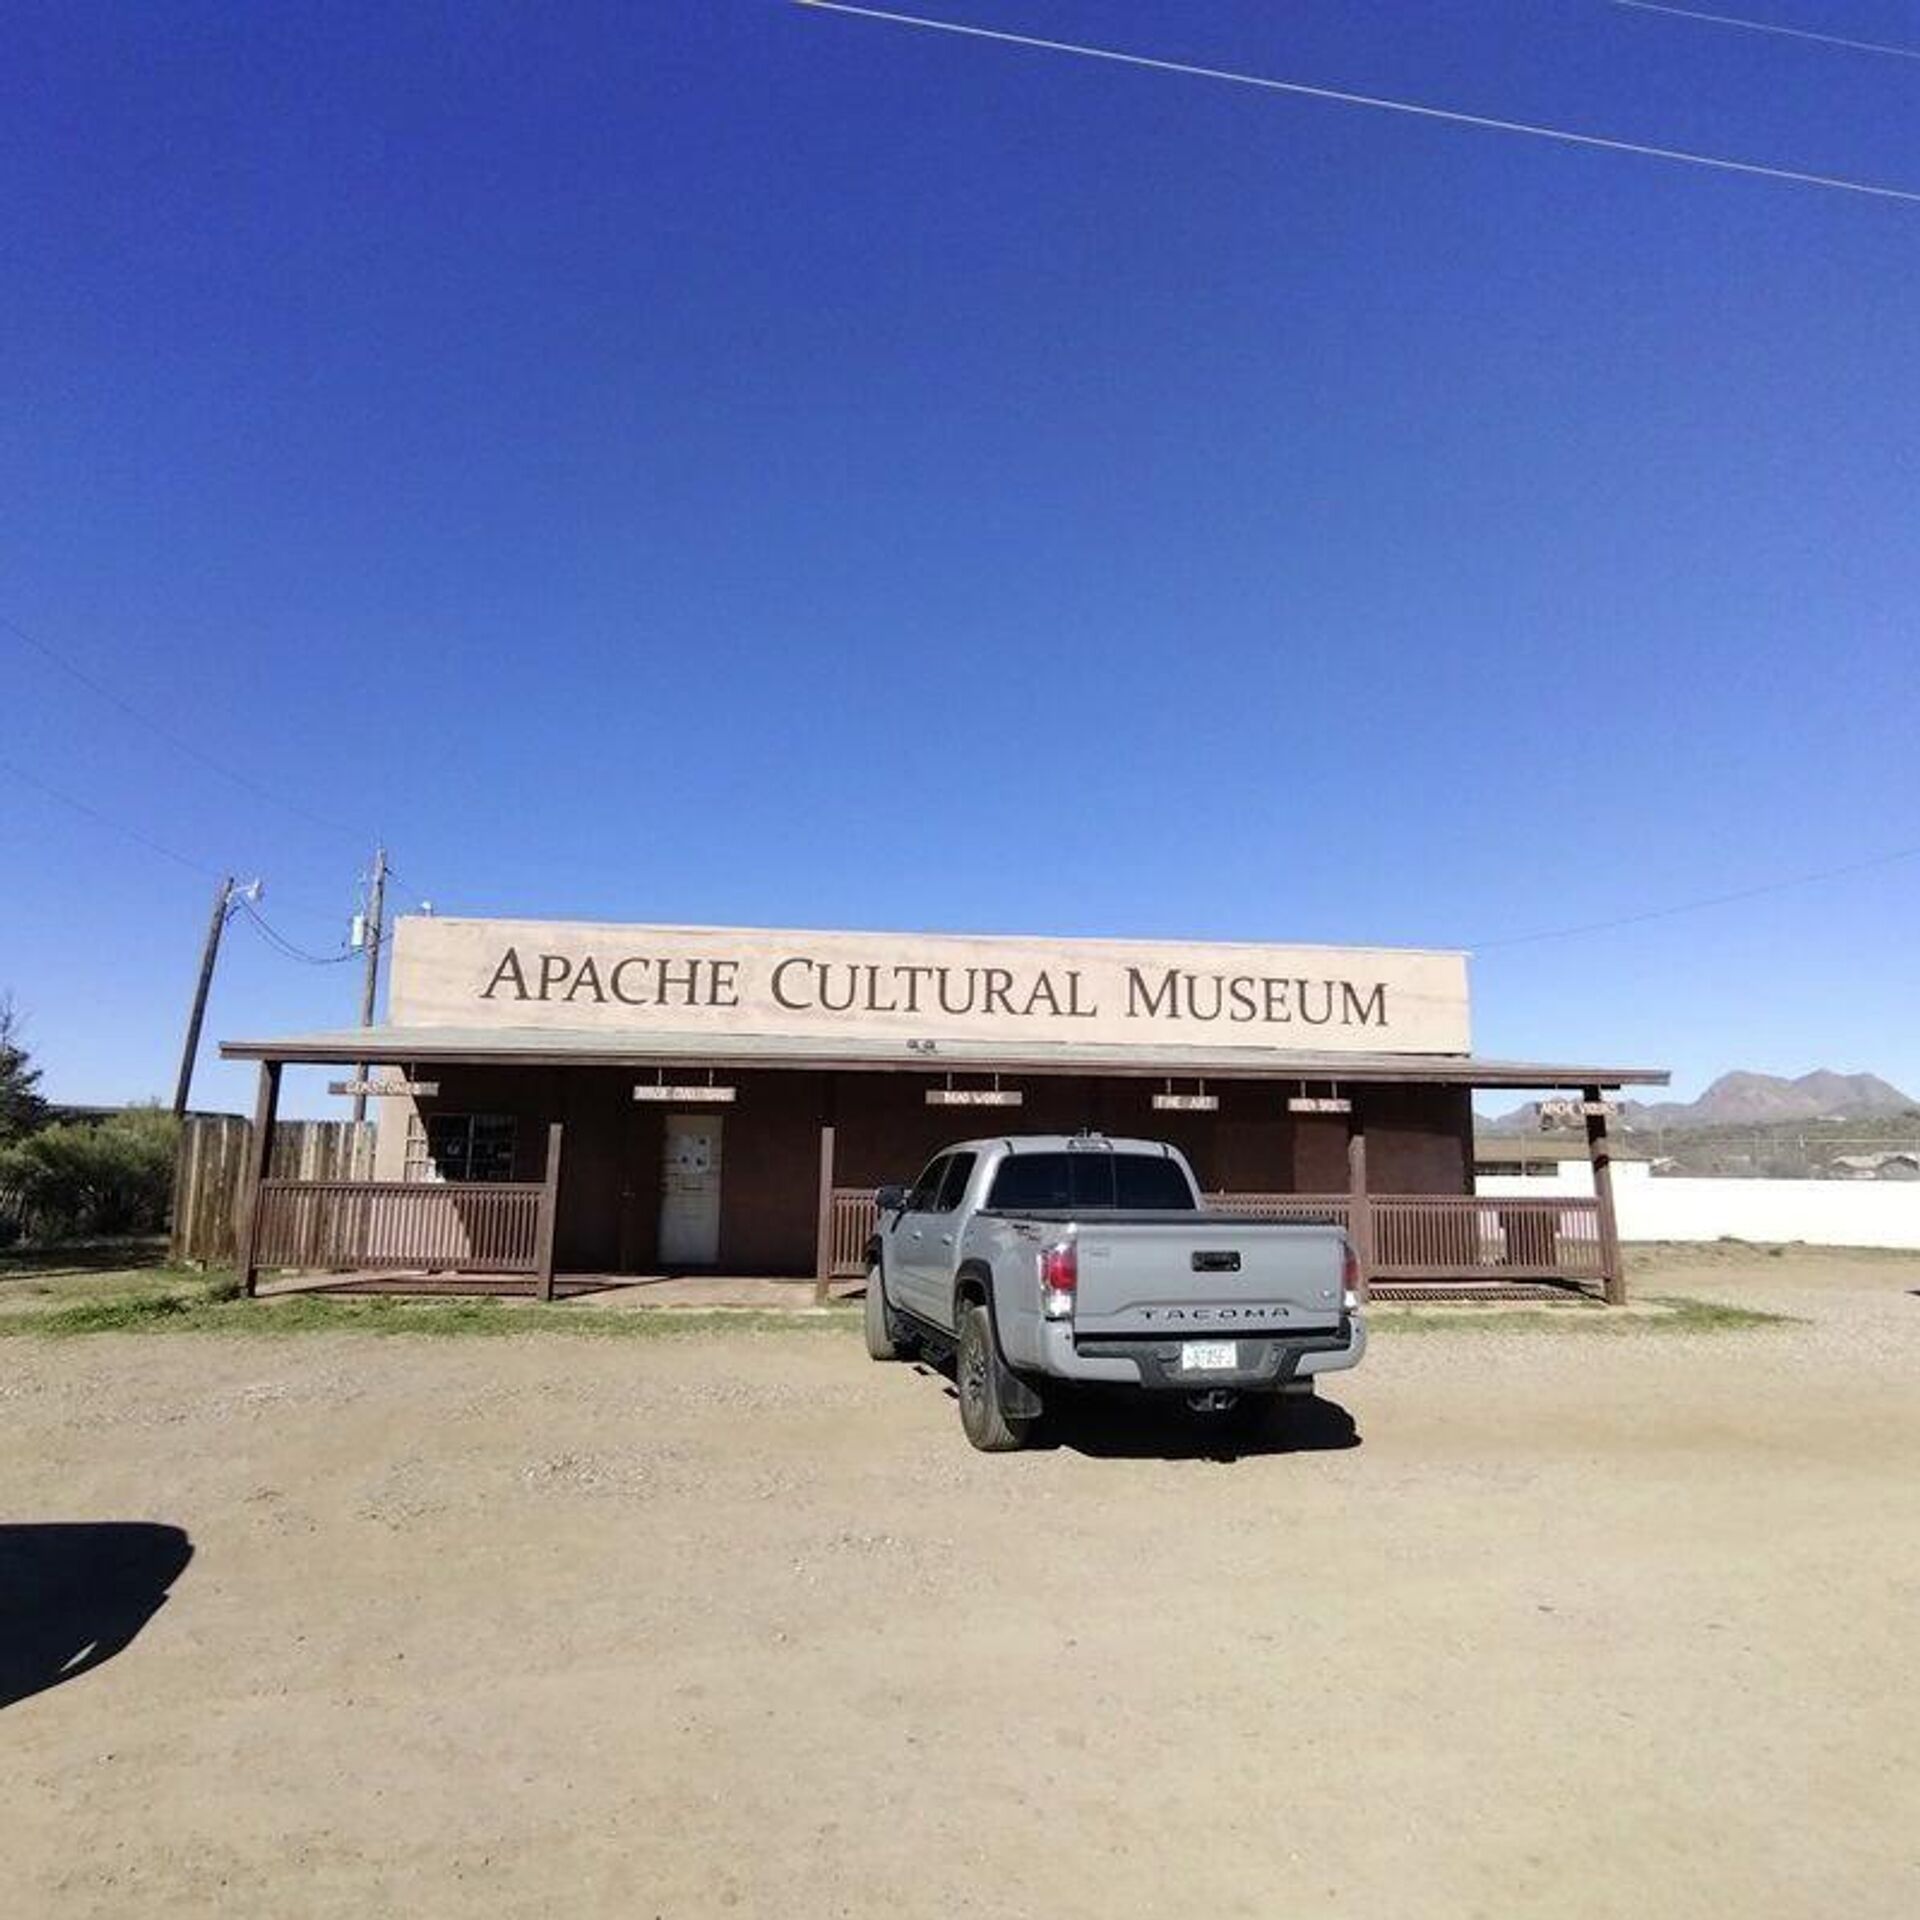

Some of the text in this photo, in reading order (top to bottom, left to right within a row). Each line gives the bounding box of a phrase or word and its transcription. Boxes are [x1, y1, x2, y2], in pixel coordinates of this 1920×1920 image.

[480, 947, 1390, 1027] APACHE CULTURAL MUSEUM
[1139, 1307, 1291, 1321] TACOMA
